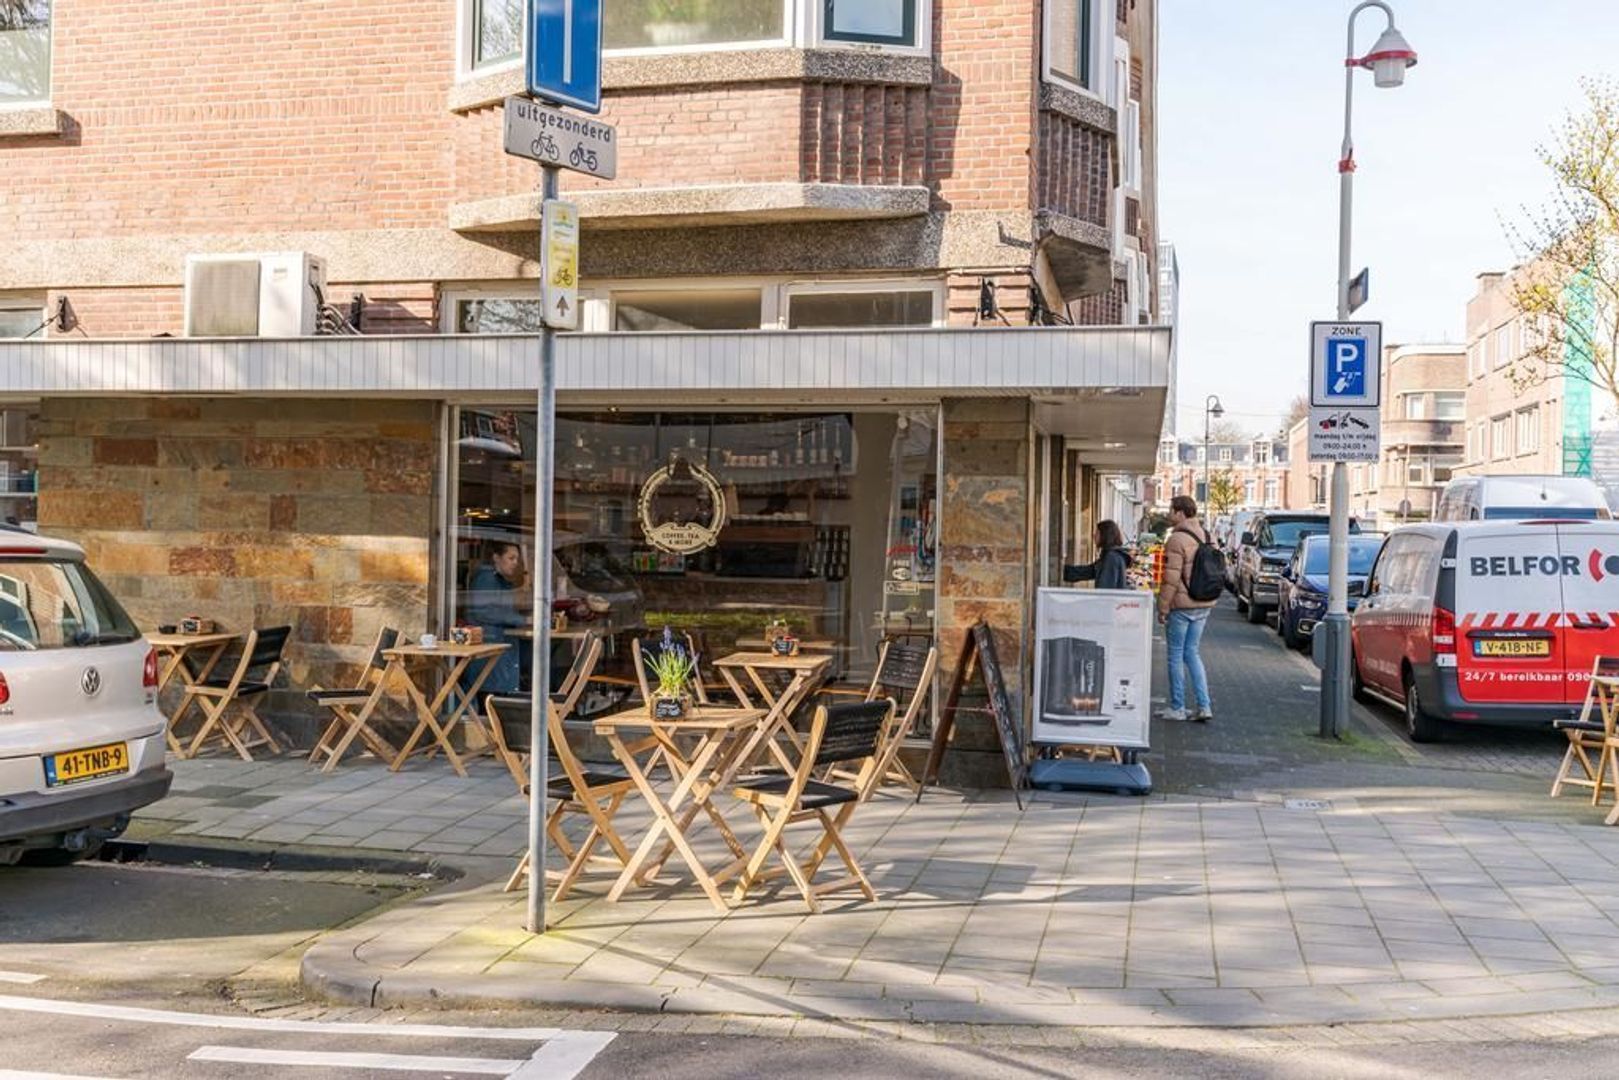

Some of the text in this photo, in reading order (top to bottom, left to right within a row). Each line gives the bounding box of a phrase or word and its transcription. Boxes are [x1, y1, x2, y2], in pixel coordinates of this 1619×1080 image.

[517, 104, 610, 142] uitgezonderd
[1331, 327, 1361, 335] ZONE
[1336, 343, 1358, 373] P
[1470, 556, 1581, 577] BELFOR
[1486, 642, 1543, 653] V-418-NF
[1465, 671, 1495, 681] 24/7
[1500, 672, 1563, 681] bereikbaar
[62, 747, 122, 775] 41-TNB-9
